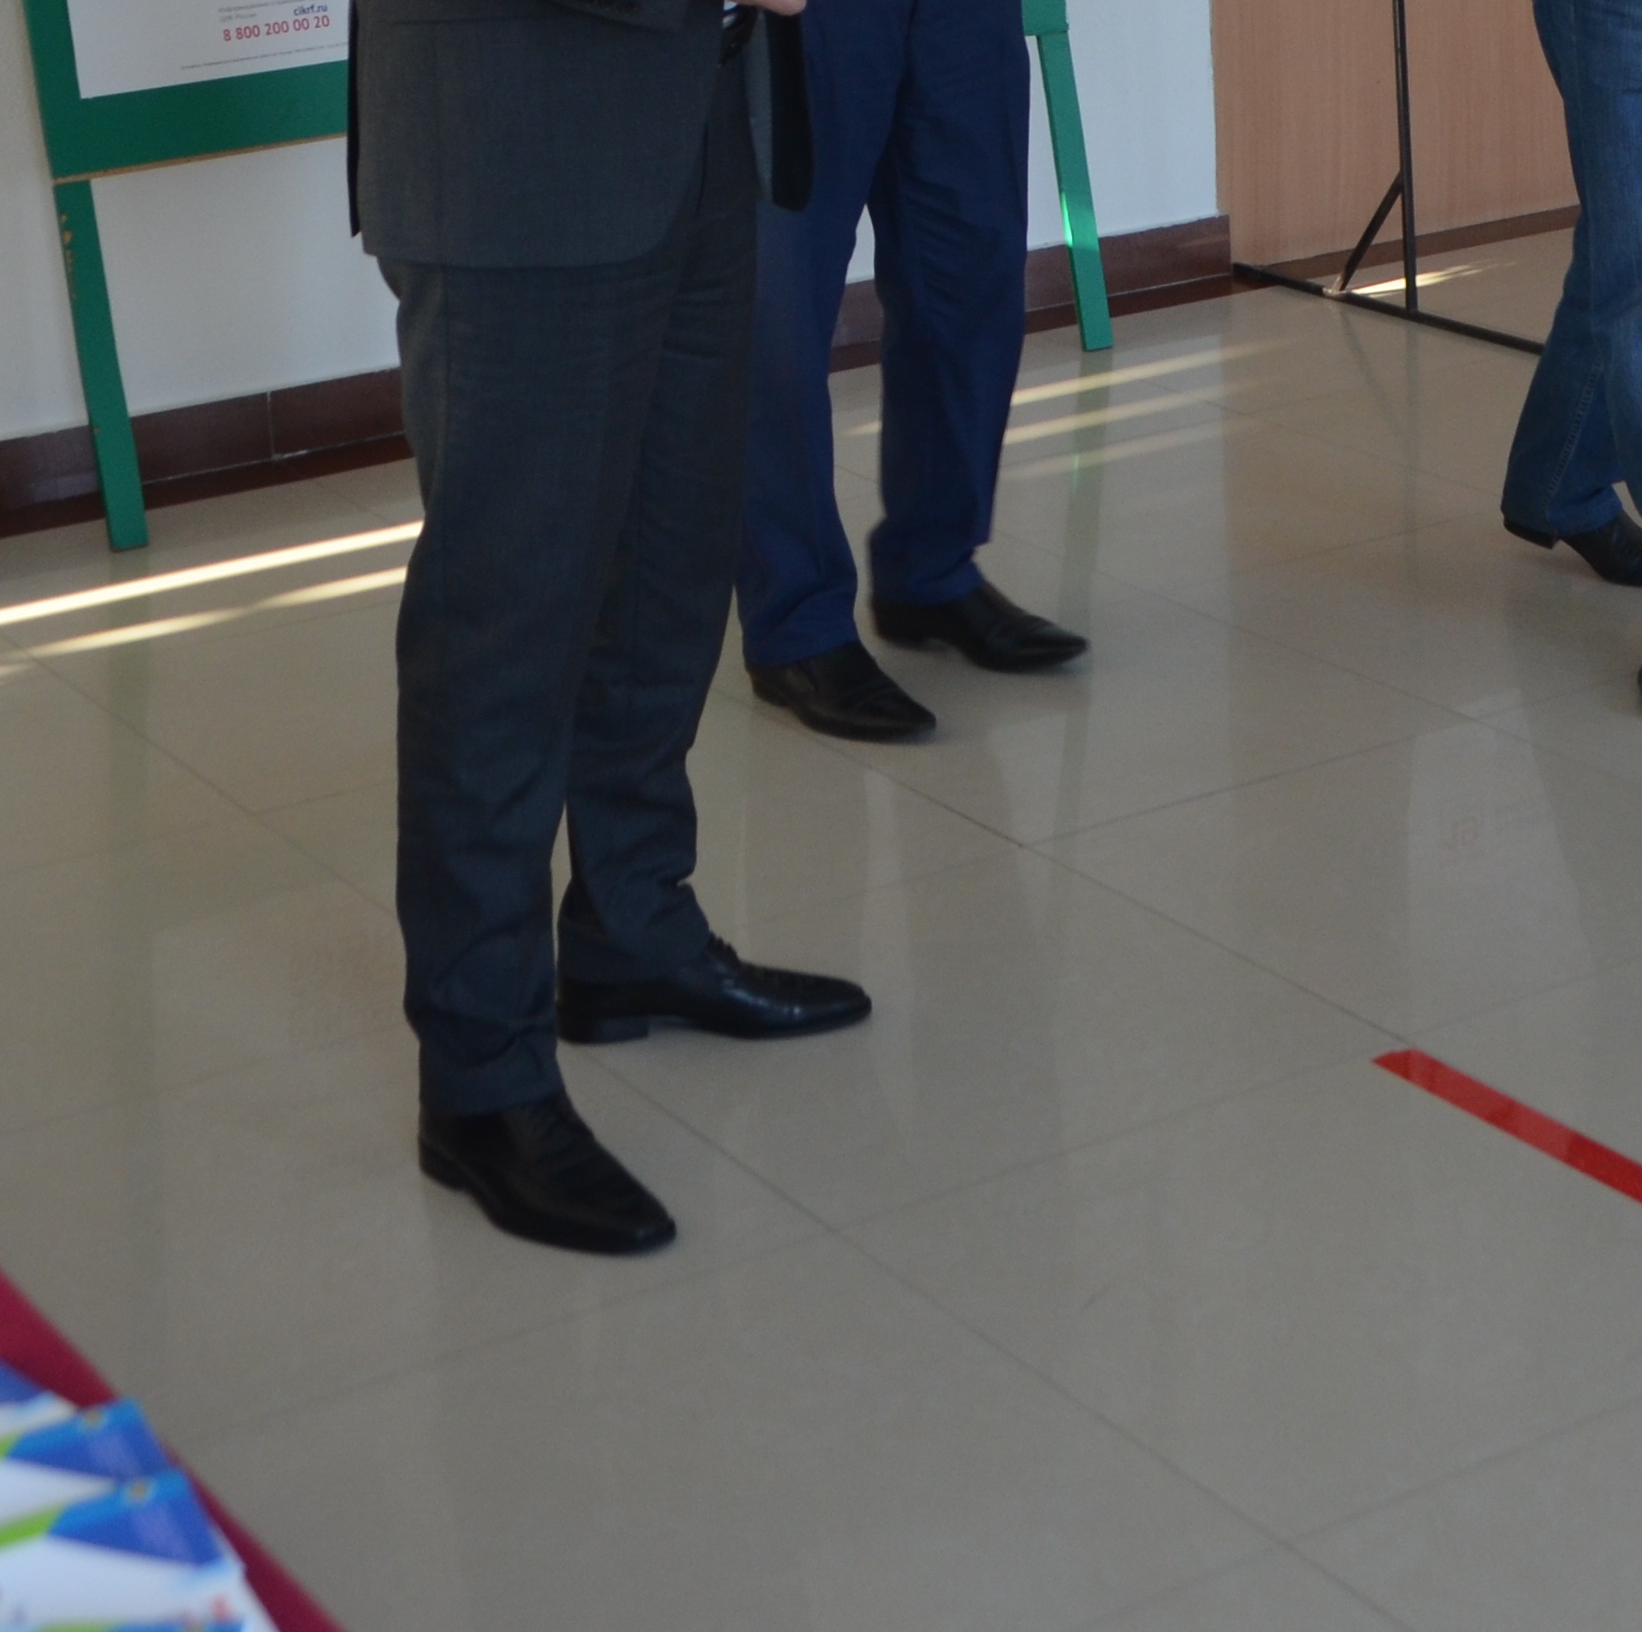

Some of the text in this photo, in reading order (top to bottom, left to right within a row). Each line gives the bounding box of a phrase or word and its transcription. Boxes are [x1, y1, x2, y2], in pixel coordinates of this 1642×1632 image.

[293, 3, 328, 16] cikrf.ru
[223, 14, 331, 42] 8 800 200 00 20
